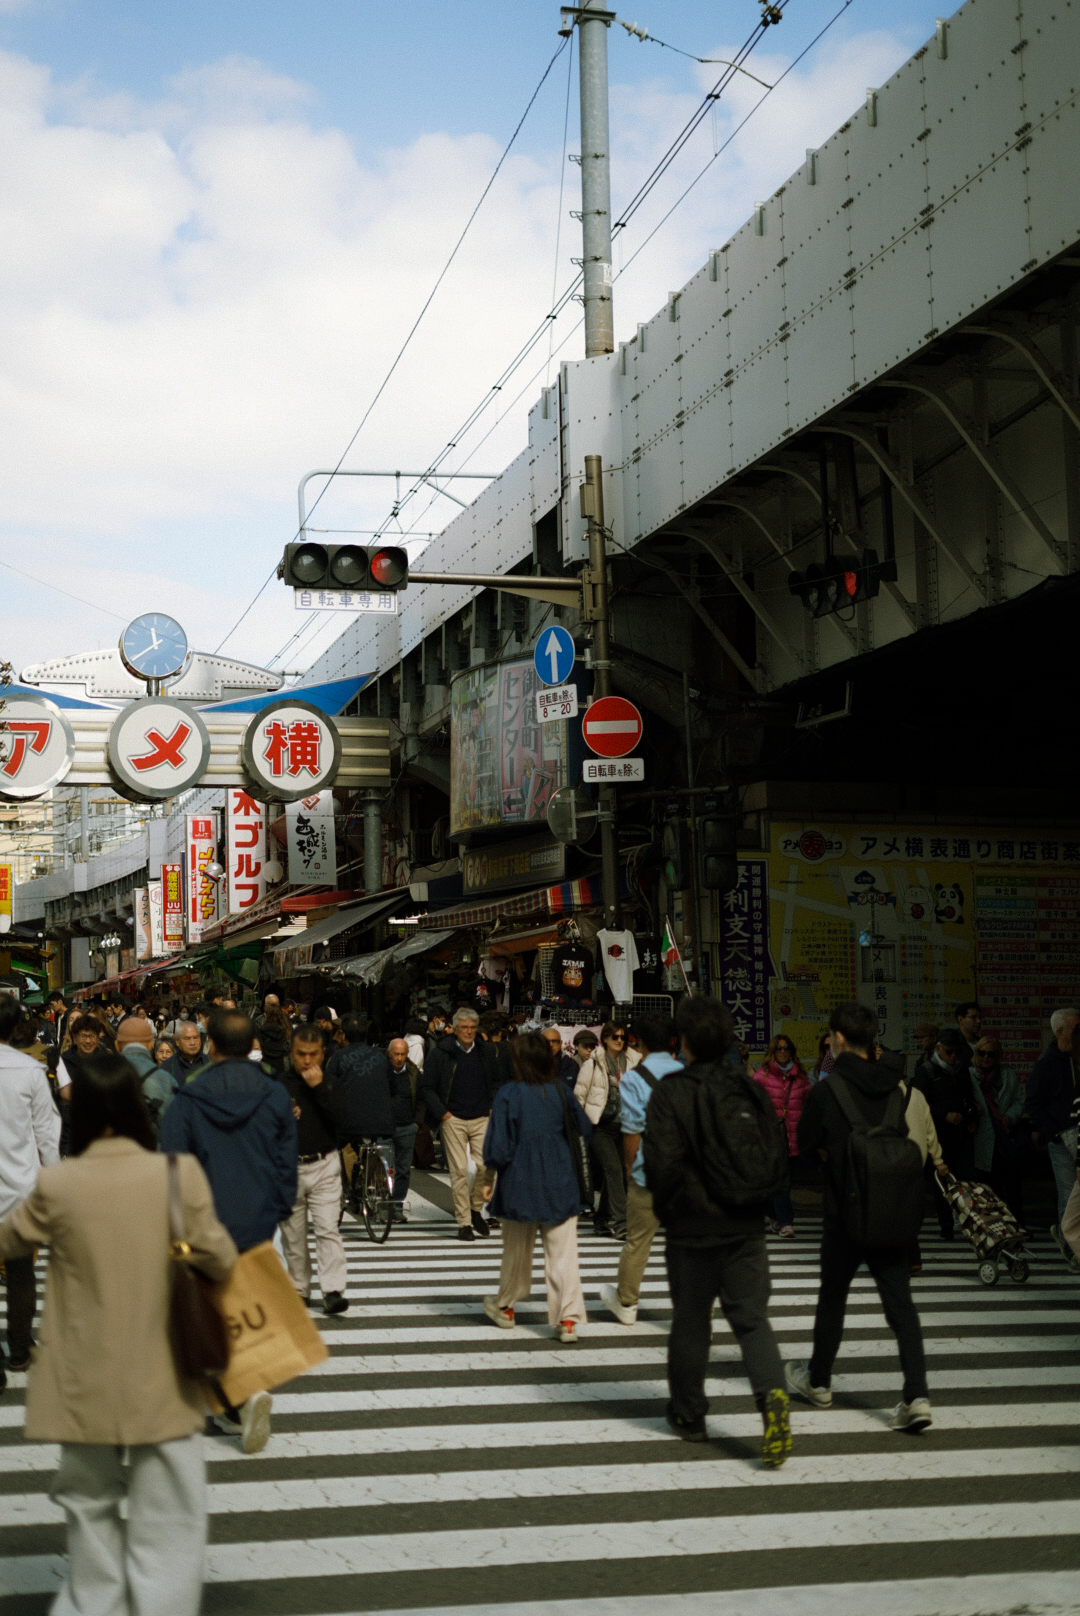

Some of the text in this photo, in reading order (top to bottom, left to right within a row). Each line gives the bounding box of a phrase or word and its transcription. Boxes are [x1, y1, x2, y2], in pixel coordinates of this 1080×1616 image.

[301, 589, 392, 609] 自転車専用
[539, 689, 574, 706] 自転車を除く
[588, 763, 639, 778] 自転車を除く
[562, 959, 586, 969] JAPAN
